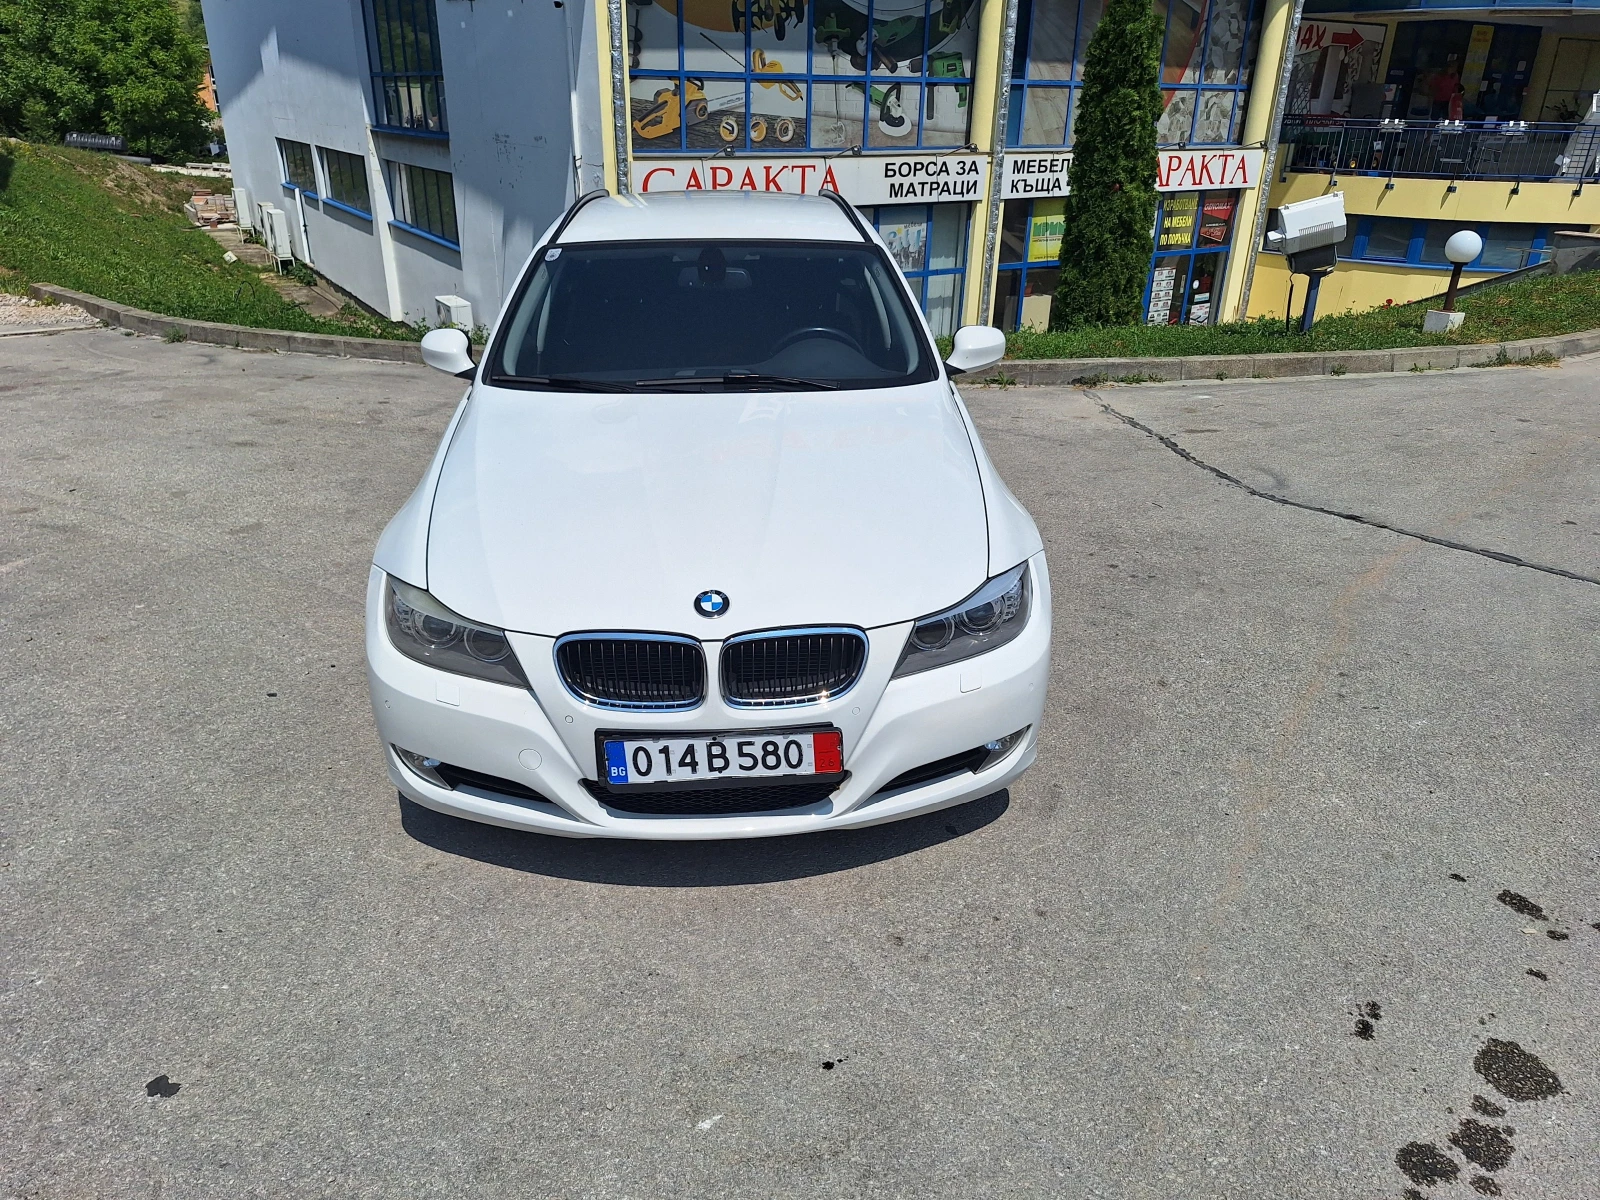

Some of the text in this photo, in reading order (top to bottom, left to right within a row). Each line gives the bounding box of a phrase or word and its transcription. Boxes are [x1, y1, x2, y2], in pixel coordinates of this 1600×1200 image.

[884, 160, 979, 178] БОРСА ЗА
[642, 164, 840, 195] САРАКТА
[1010, 177, 1062, 194] КЪЩА
[889, 179, 978, 198] МАТРАЦИ
[1164, 217, 1171, 228] НА
[1172, 215, 1193, 227] МЕБЕЛИ
[1160, 233, 1191, 245] ПО ПОРЪЧКА
[632, 739, 804, 777] 014B580
[611, 766, 626, 777] BG
